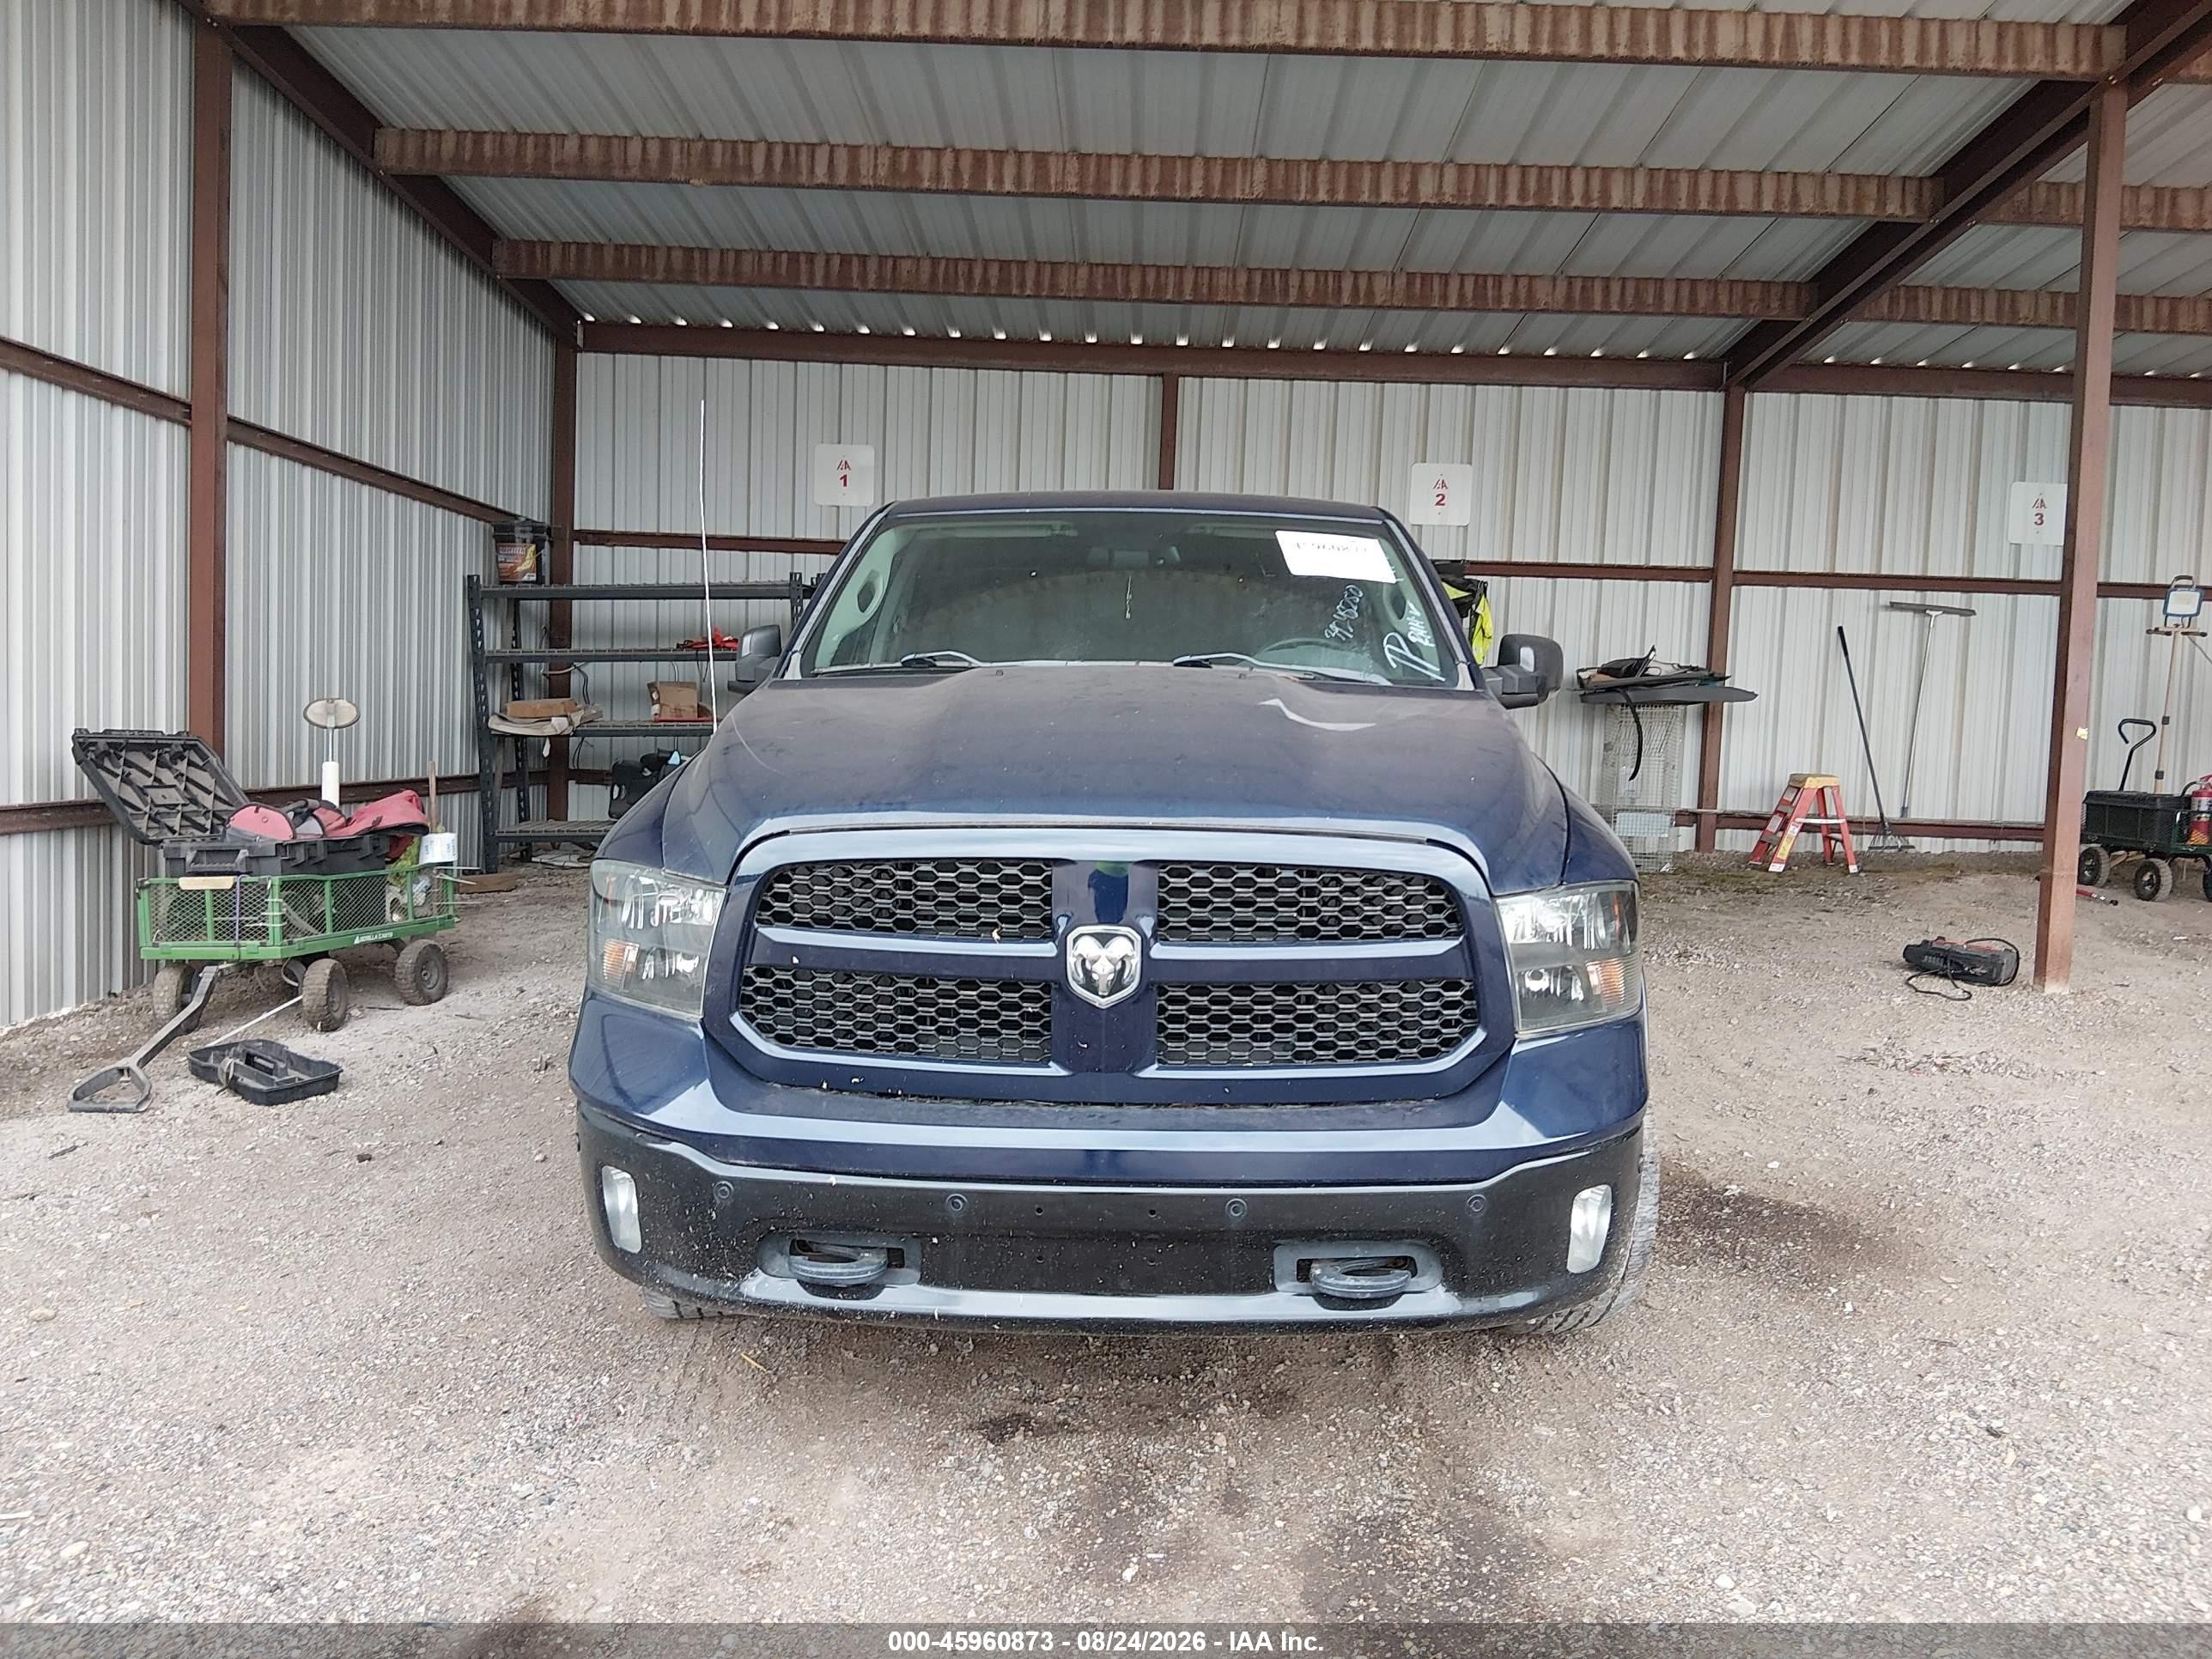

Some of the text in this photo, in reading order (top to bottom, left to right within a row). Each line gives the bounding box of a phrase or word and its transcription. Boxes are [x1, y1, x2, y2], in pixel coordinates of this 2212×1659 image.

[839, 474, 848, 488] 1
[1434, 493, 1446, 507] 2
[2033, 513, 2045, 526] 3
